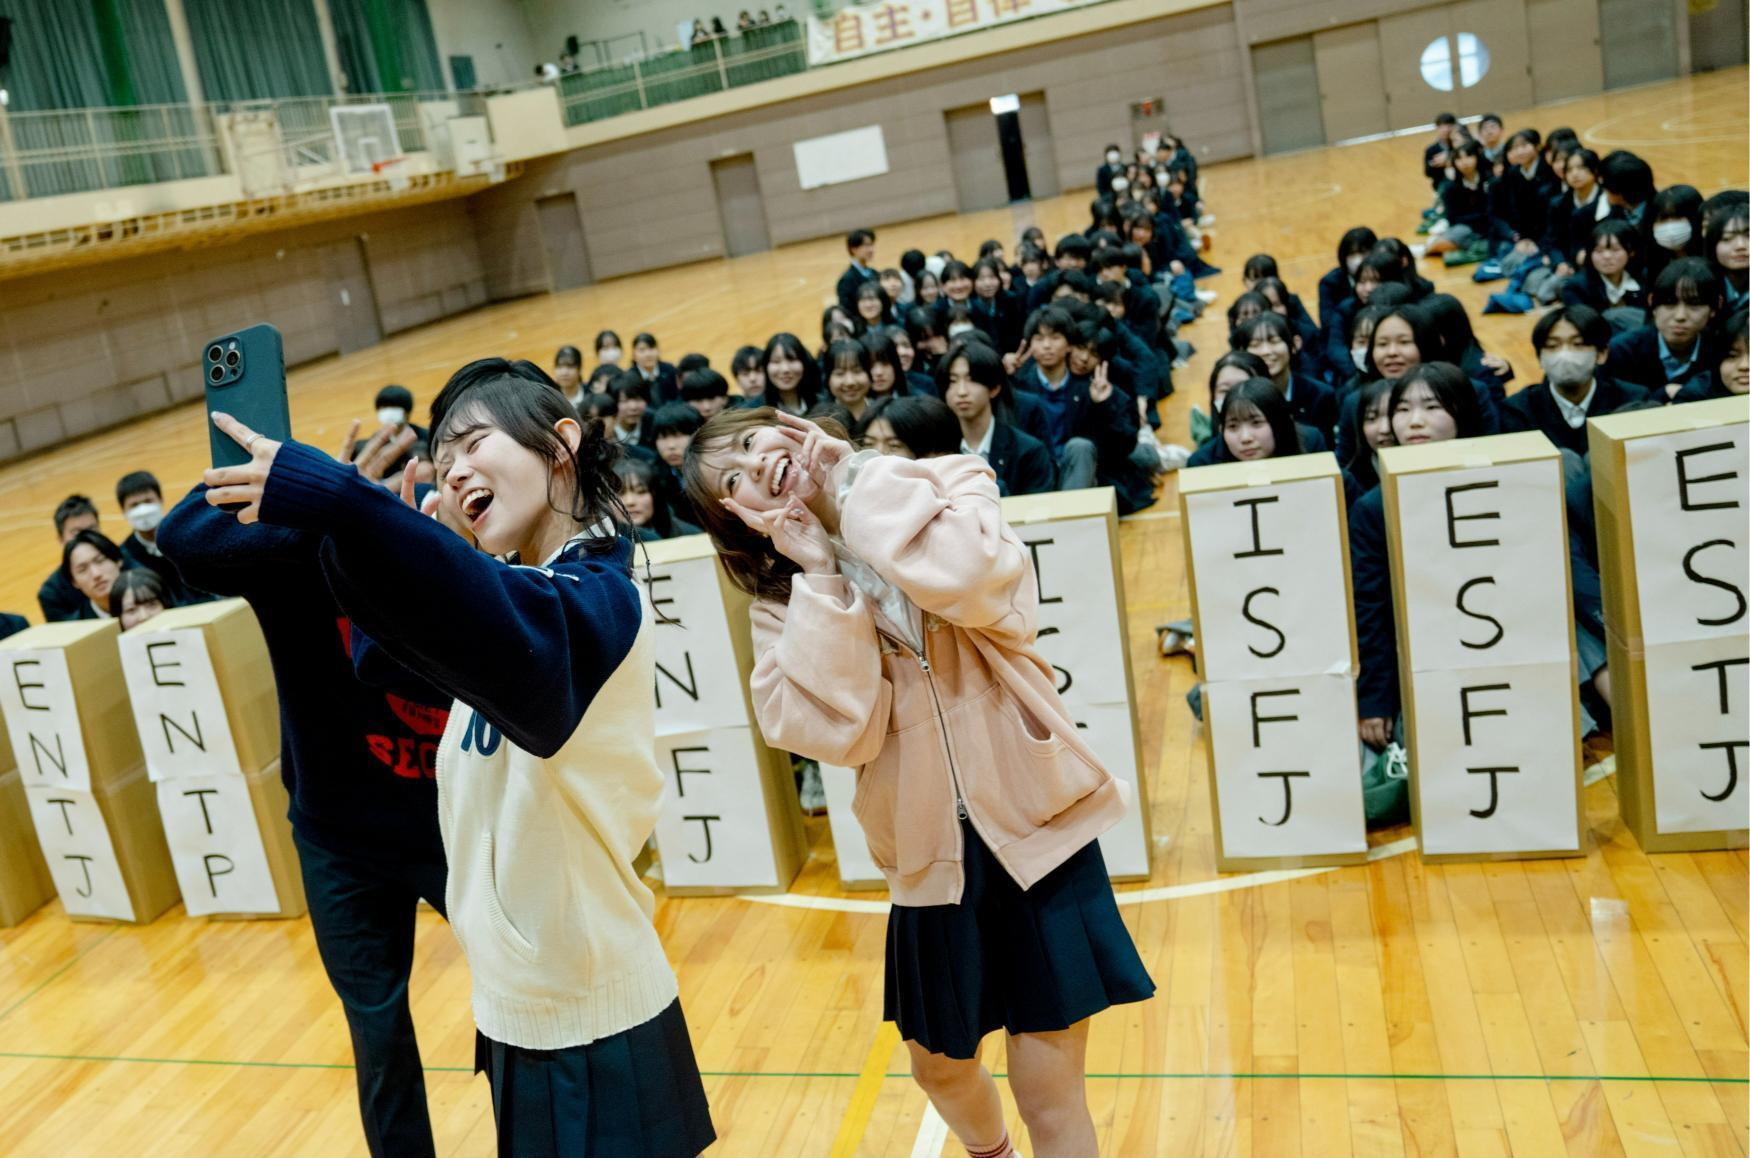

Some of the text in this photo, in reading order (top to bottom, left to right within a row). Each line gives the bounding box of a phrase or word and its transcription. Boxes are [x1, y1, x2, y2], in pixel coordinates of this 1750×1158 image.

[146, 641, 235, 898] ENTP
[642, 575, 720, 864] ENFJ
[1232, 495, 1311, 827] ISFJ
[1445, 480, 1520, 819] ESFJ
[1675, 441, 1748, 802] ESTJ
[13, 660, 94, 898] ENTJ
